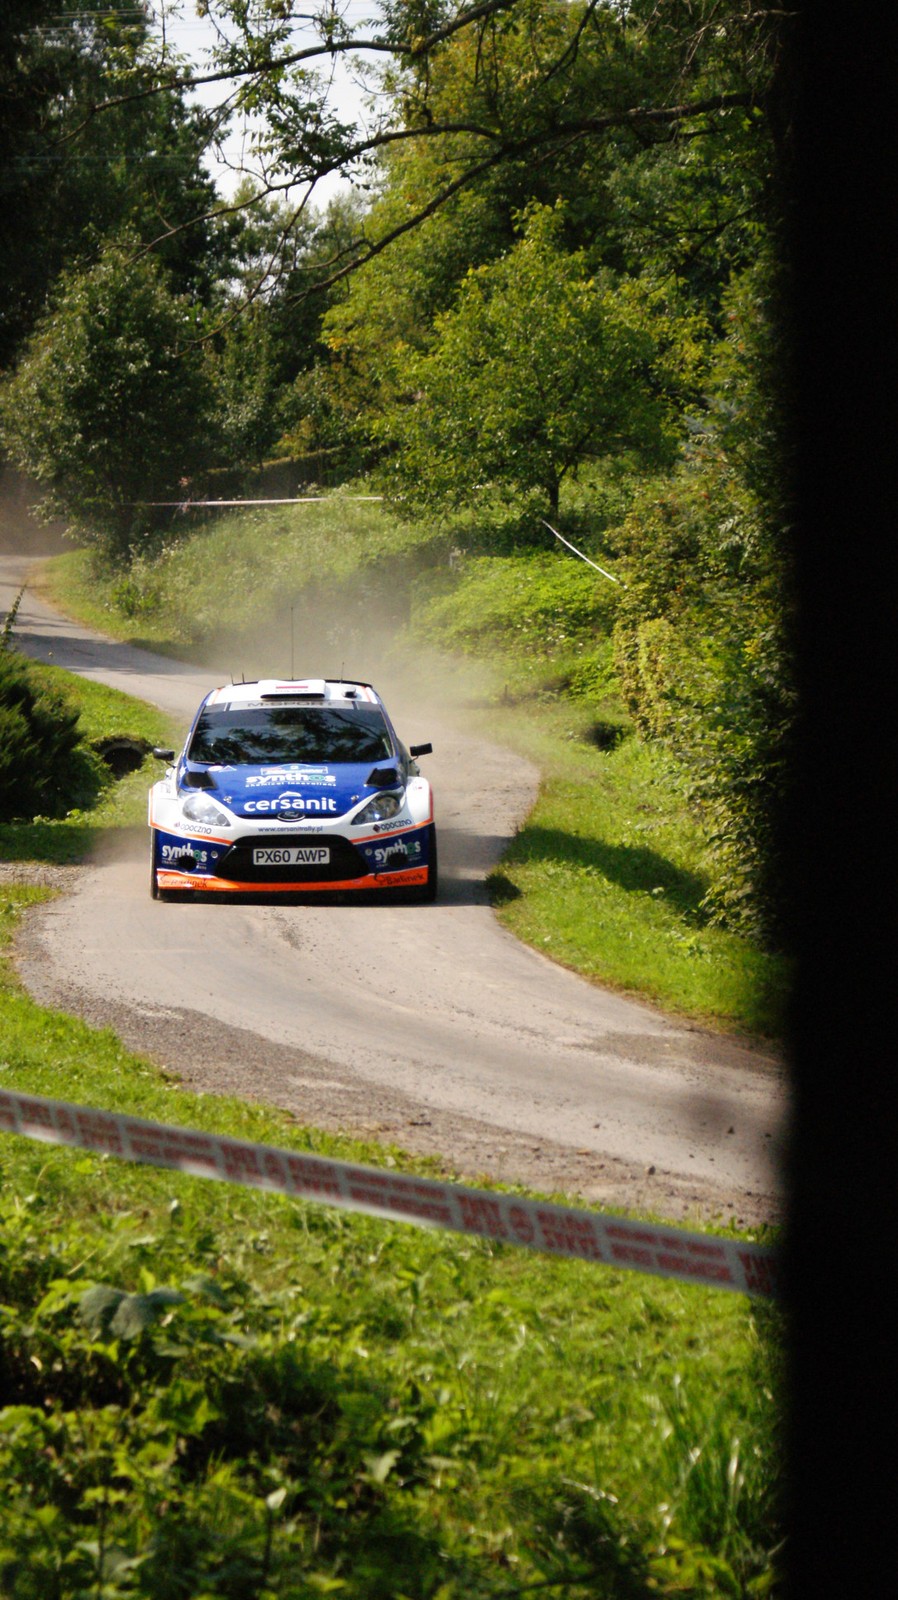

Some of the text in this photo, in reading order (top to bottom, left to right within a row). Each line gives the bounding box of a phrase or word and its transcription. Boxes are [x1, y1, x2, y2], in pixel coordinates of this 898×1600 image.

[245, 773, 337, 785] synthos
[243, 797, 337, 812] cersanit
[180, 823, 213, 835] opoczno
[258, 825, 324, 833] www.cersanitrally.pl
[381, 818, 412, 831] opoczno
[162, 842, 208, 863] synthos
[255, 849, 327, 864] PX60 AWP
[374, 838, 421, 864] synthos
